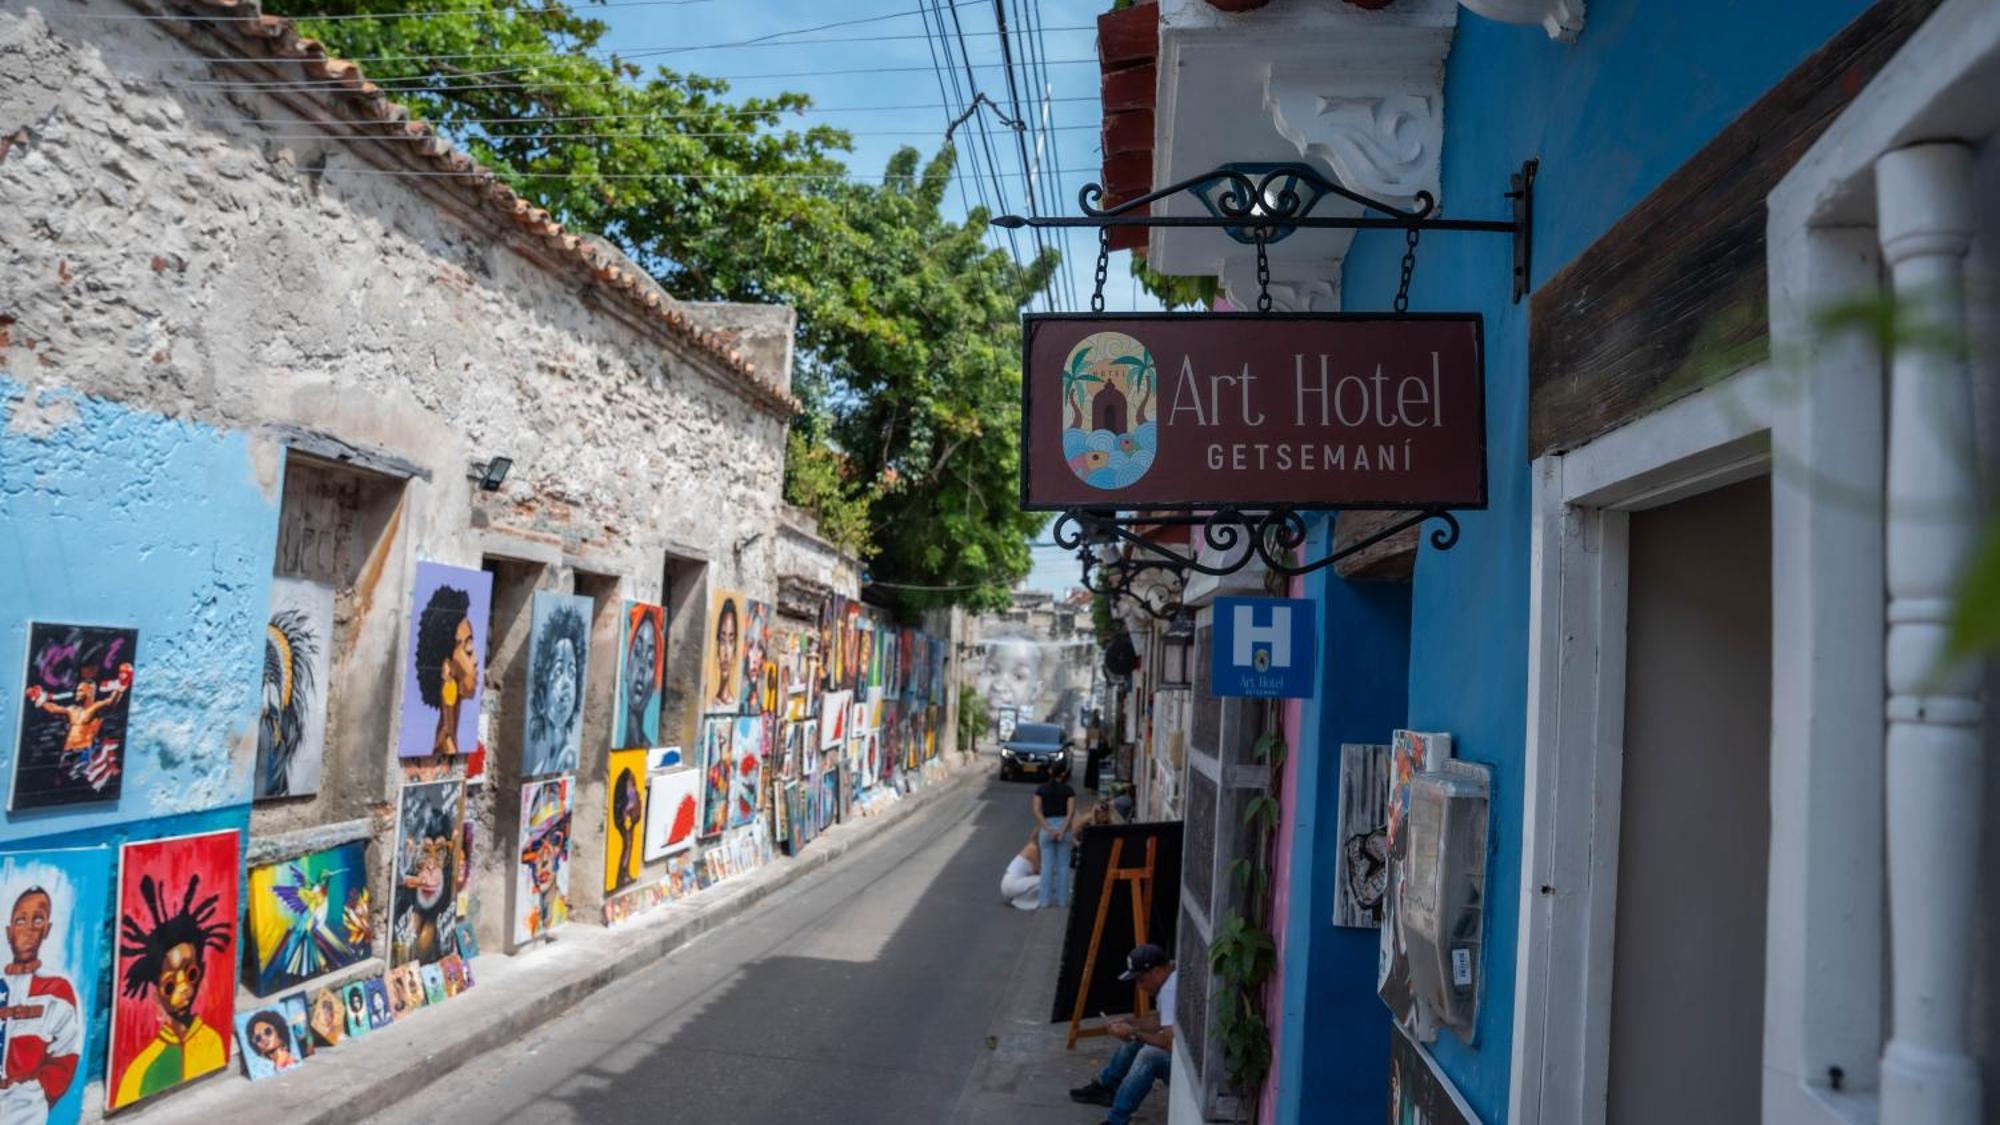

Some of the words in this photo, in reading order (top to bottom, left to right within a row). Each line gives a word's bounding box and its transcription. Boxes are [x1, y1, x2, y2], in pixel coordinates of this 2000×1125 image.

[1167, 352, 1266, 427] Art
[1294, 351, 1444, 428] Hotel
[1207, 438, 1412, 471] GETSEMANÍ
[1233, 605, 1291, 667] H
